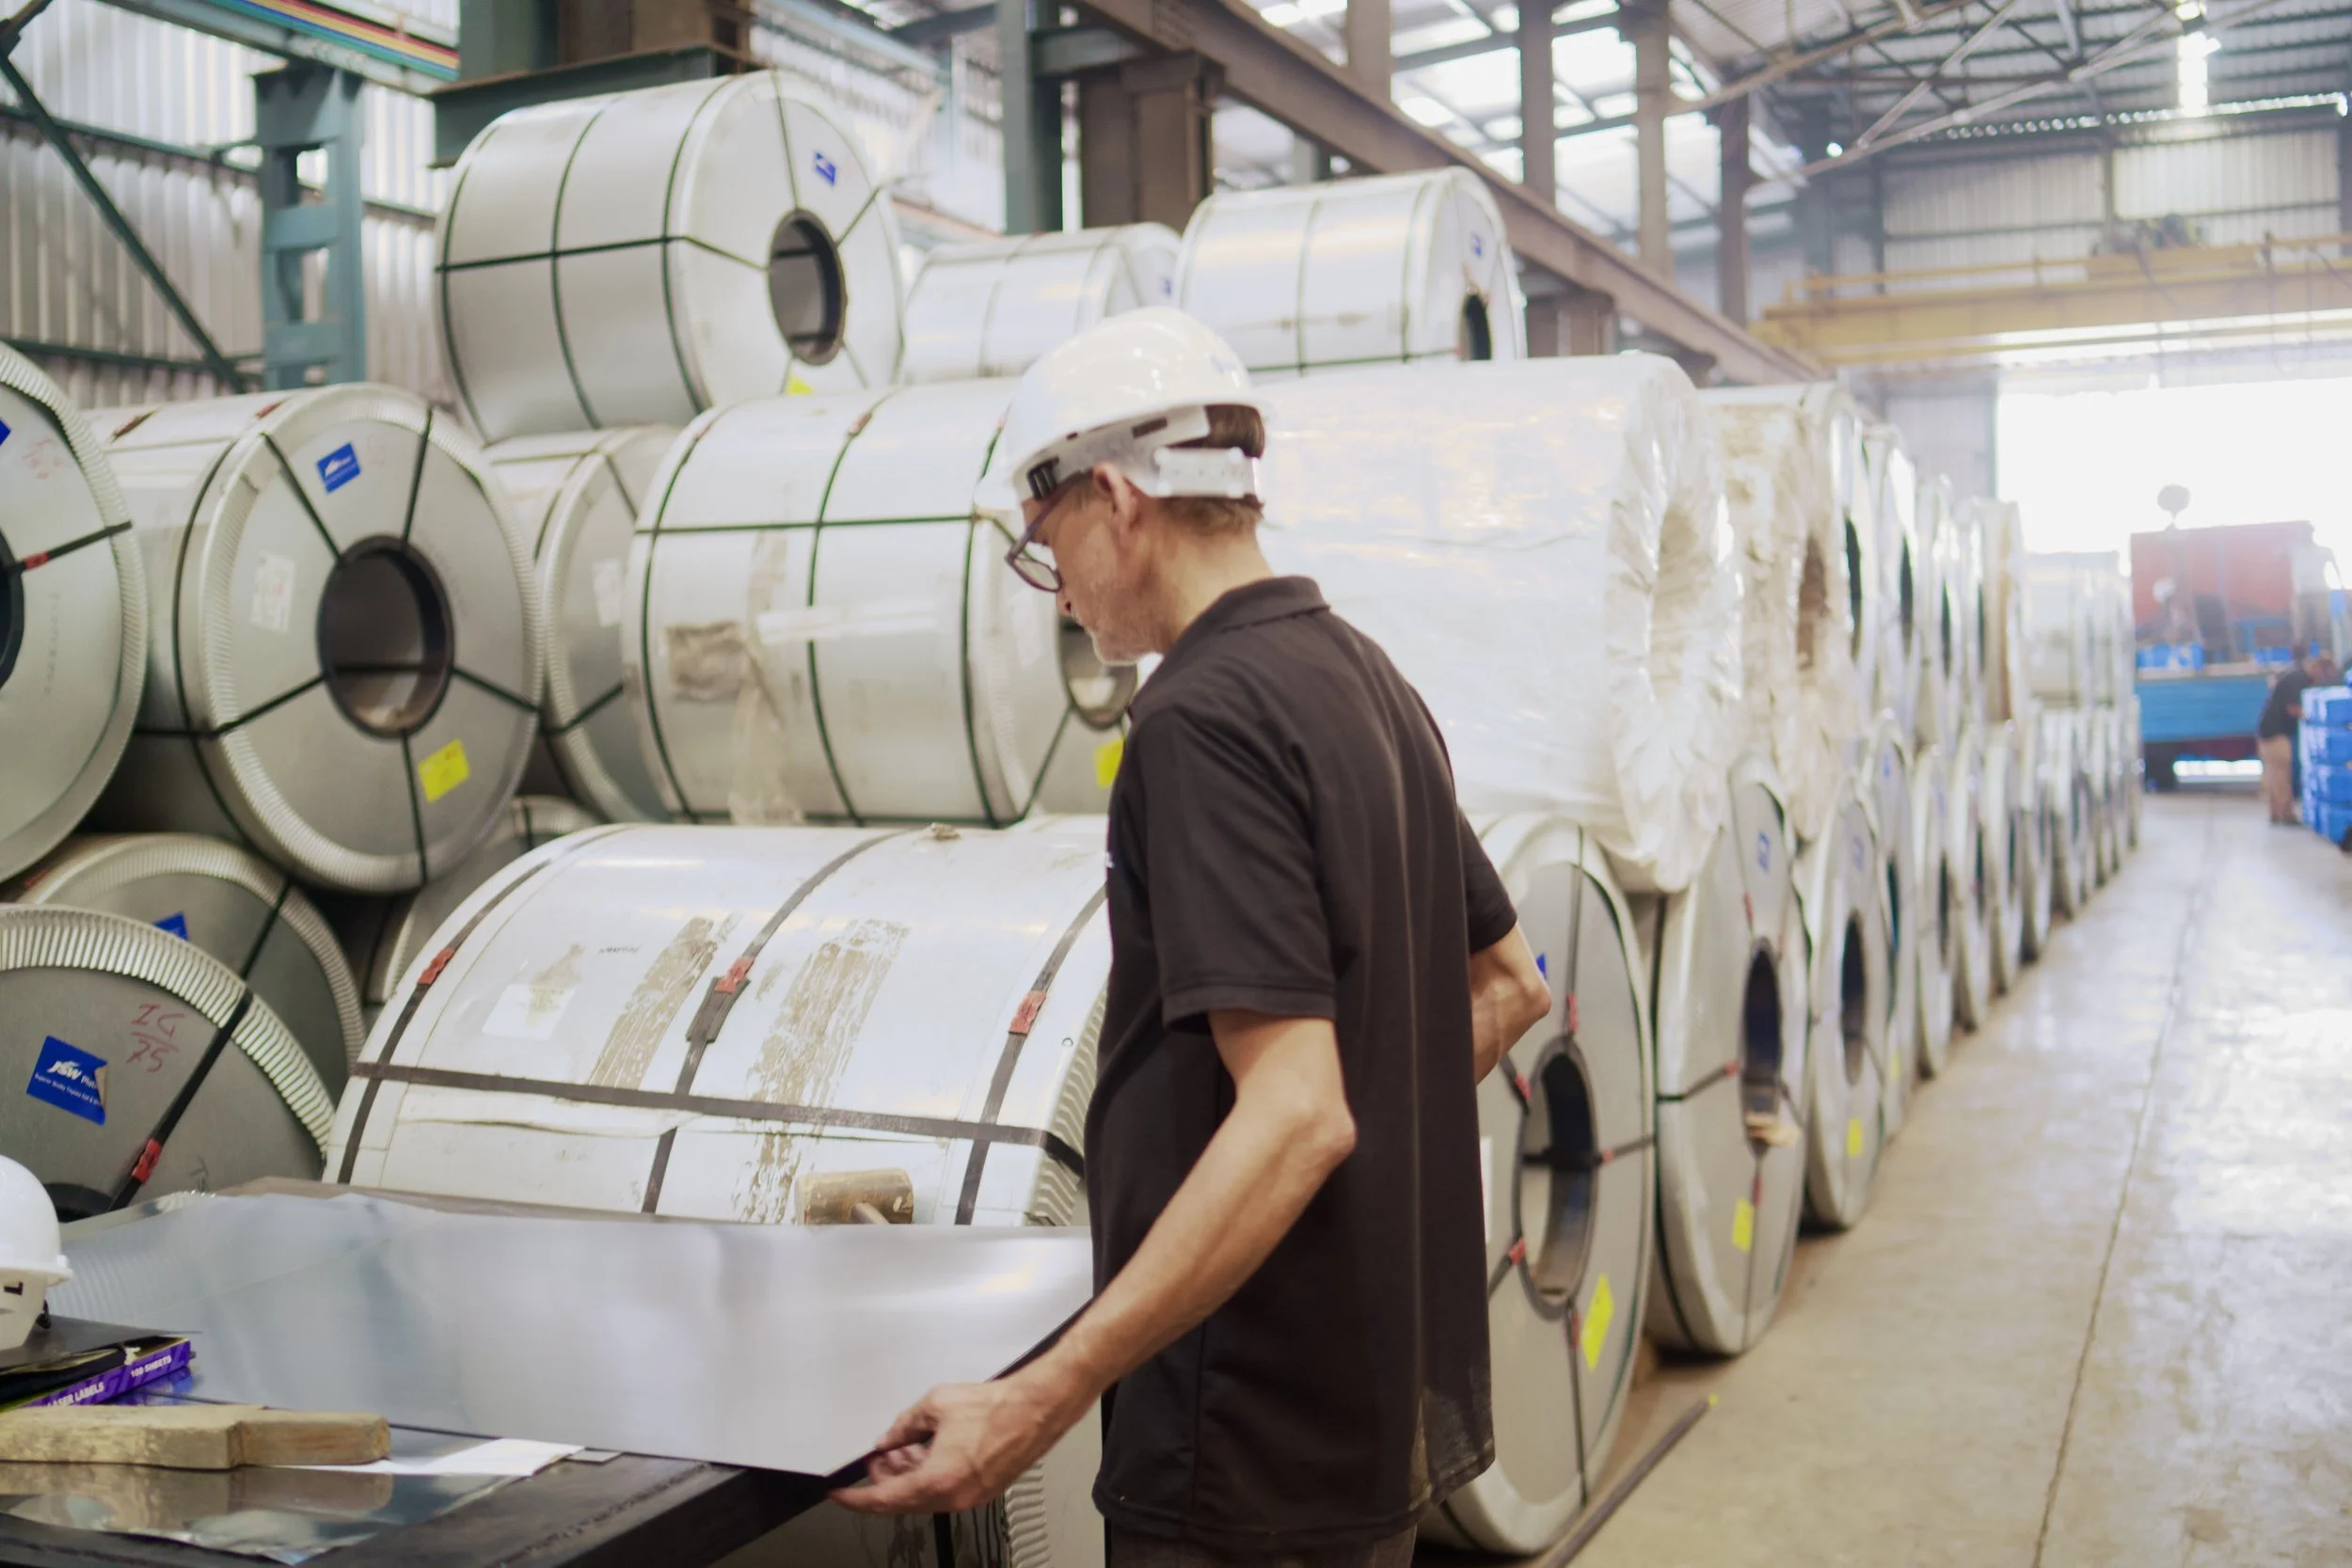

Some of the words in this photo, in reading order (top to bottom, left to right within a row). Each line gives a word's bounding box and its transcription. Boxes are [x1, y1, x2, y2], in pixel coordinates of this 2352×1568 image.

[47, 1061, 83, 1081] JSW
[131, 1366, 144, 1378] 100
[145, 1354, 172, 1372] SHEETS
[74, 1382, 104, 1402] LABELS
